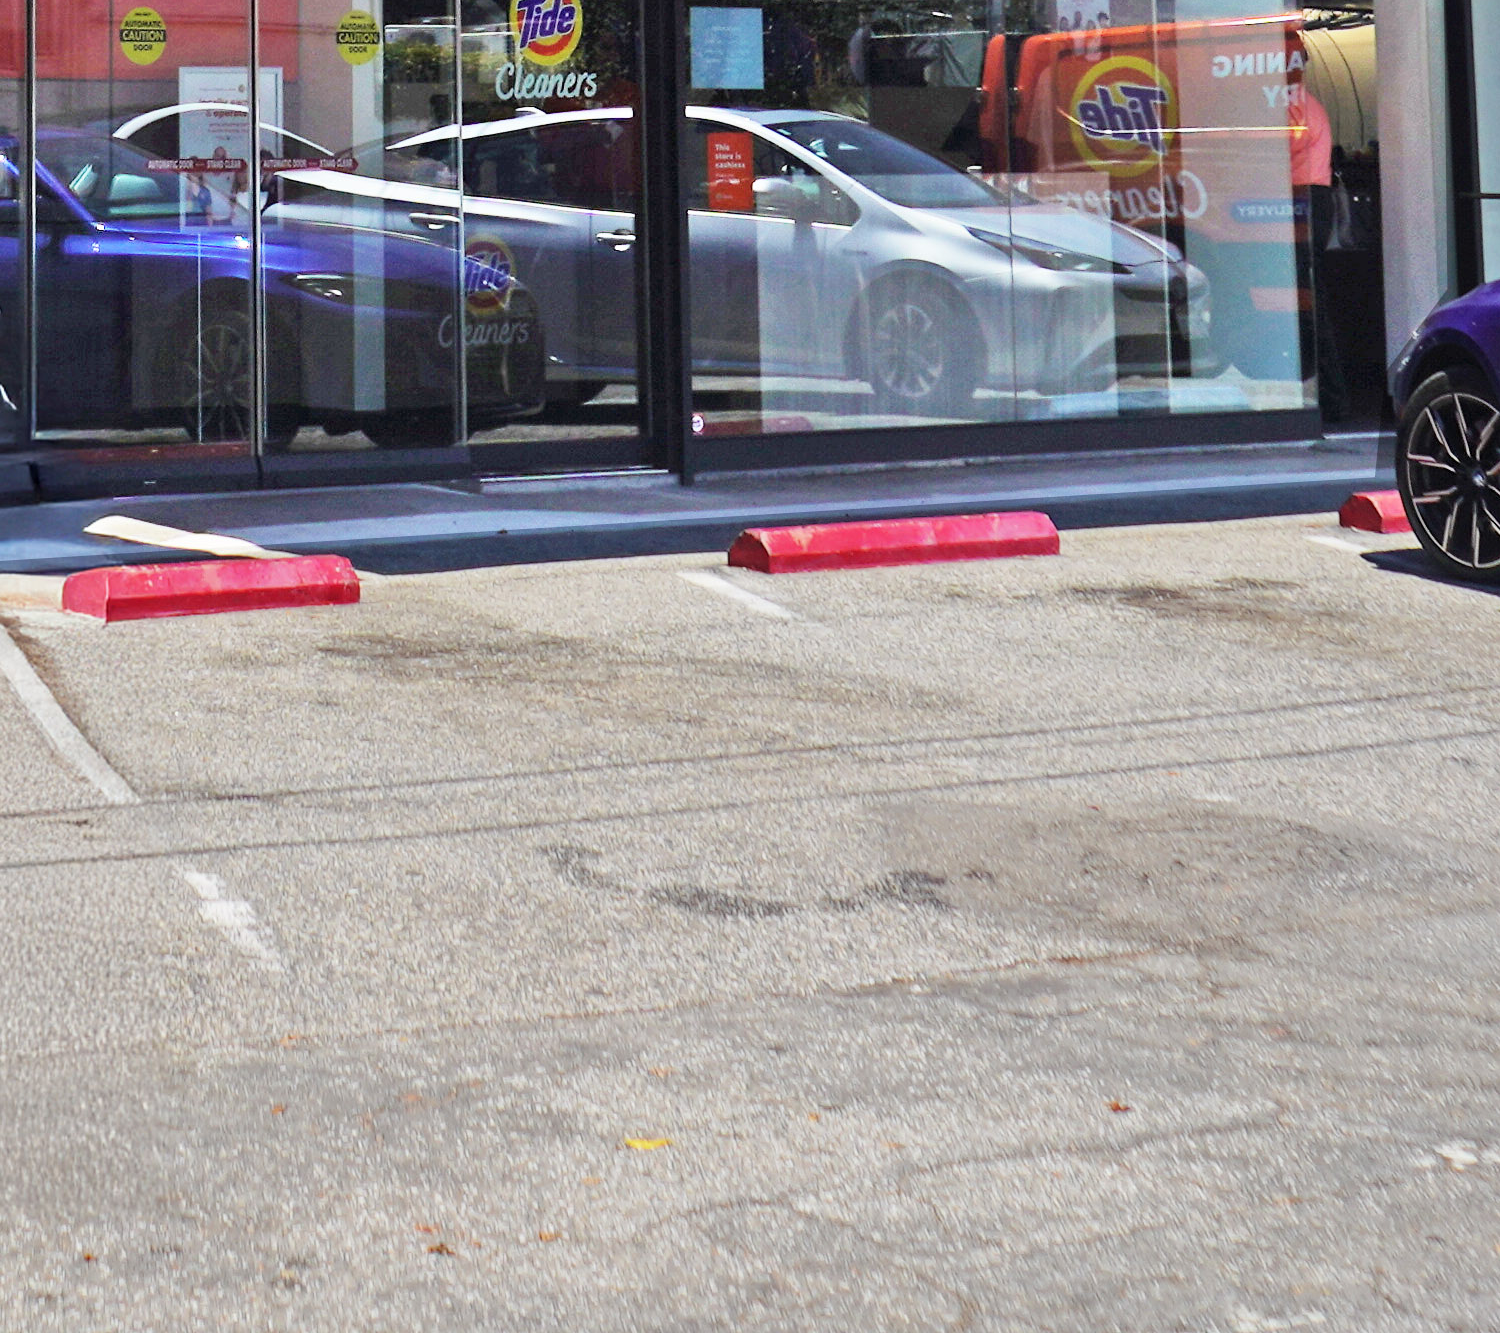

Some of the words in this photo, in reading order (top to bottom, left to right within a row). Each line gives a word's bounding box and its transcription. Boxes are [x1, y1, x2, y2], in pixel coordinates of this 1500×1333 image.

[122, 30, 164, 41] CAUTION
[338, 33, 378, 44] CAUTION
[495, 61, 599, 101] Cleaners
[437, 314, 531, 348] Ceaners
